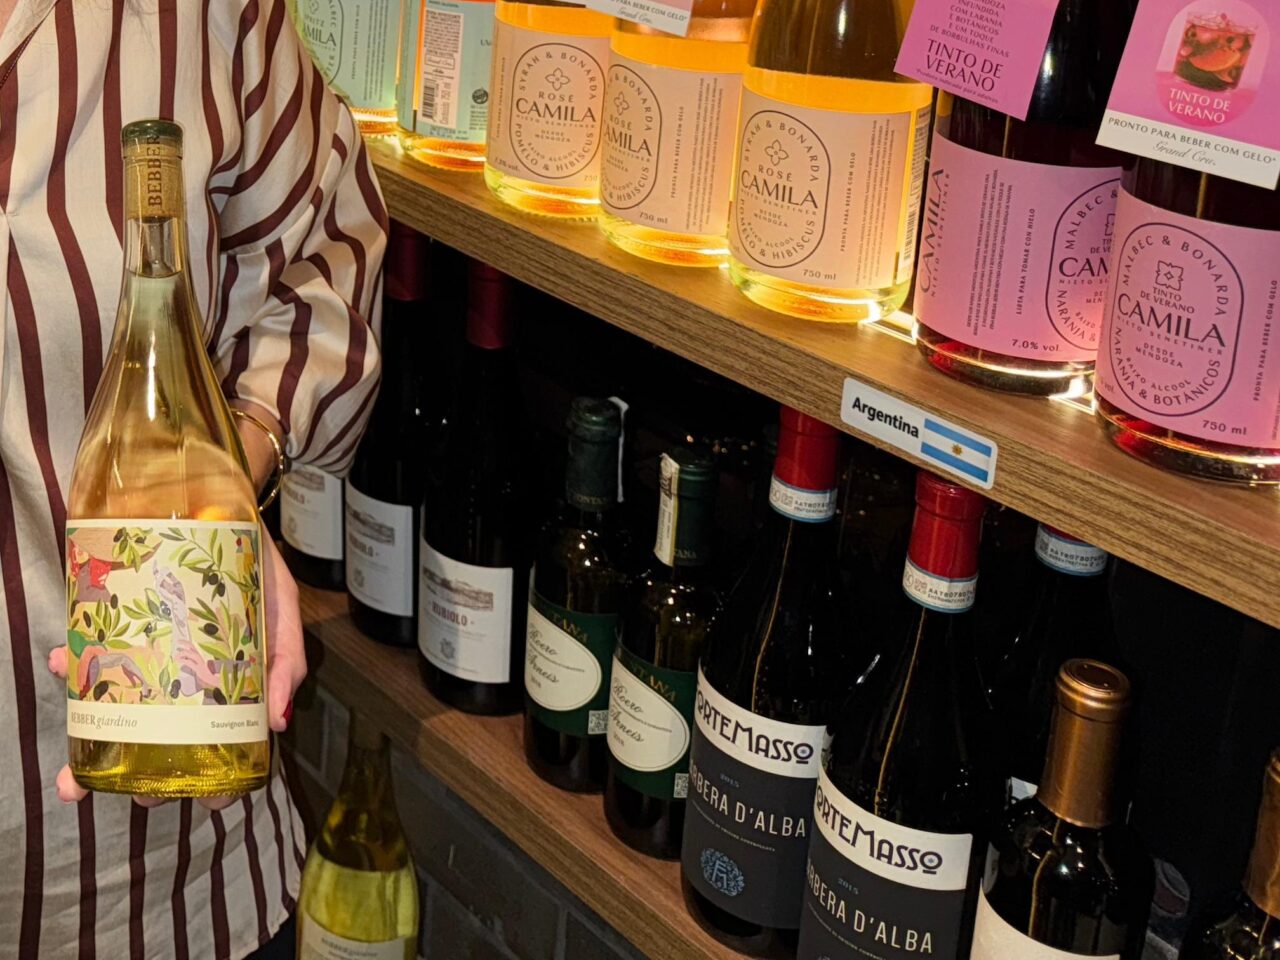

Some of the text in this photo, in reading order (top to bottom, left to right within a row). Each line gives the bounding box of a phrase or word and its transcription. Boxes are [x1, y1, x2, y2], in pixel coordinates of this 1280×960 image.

[632, 0, 650, 12] BEBER
[650, 4, 667, 16] COM
[950, 4, 969, 16] COM
[930, 24, 1010, 58] DE BORBULHAS FINAS
[969, 27, 996, 44] TOQUE
[519, 51, 598, 100] SYRAH & BONARDA
[926, 54, 996, 93] VERANO
[927, 38, 1005, 80] TINTO DE
[515, 97, 597, 123] CAMILA
[538, 90, 575, 103] ROSÉ
[623, 75, 653, 132] BONARDA
[1168, 100, 1226, 125] VERANO
[1170, 87, 1231, 113] TINTO DE
[515, 123, 594, 173] POMELO & HIBISCUS
[779, 121, 820, 183] BONARDA
[1108, 117, 1149, 136] PRONTO
[1150, 127, 1178, 142] PARA
[1180, 134, 1212, 151] BEBER
[1213, 142, 1240, 157] COM
[146, 135, 163, 208] BEBBER
[616, 165, 651, 202] HIBISCUS
[741, 169, 819, 210] CAMILA
[758, 164, 793, 183] ROSÉ
[772, 219, 816, 260] HIBISCUS
[920, 167, 945, 294] CAMILA
[1064, 194, 1104, 250] MALBEC
[802, 268, 837, 281] 750 ml
[1122, 234, 1230, 317] MALBEC & BONARDA
[1140, 291, 1196, 315] DE VERANO
[1151, 286, 1183, 303] TINTO
[1057, 289, 1086, 342] NARANJA
[1117, 292, 1226, 348] CAMILA
[1134, 346, 1184, 369] MENDOZA
[1142, 342, 1175, 358] DESDE
[1253, 279, 1278, 402] PRONTA PARA BEBER COM GELO
[1113, 327, 1148, 400] NARANJA &
[1125, 356, 1147, 384] BAIXO
[852, 396, 920, 439] Argentina
[1201, 418, 1248, 436] 750 ml
[210, 720, 246, 730] Sauvignon
[696, 688, 814, 765] ORTEMASSO
[735, 801, 807, 838] D'ALBA
[816, 784, 943, 876] ORTEMASSO
[853, 909, 933, 954] D'ALBA
